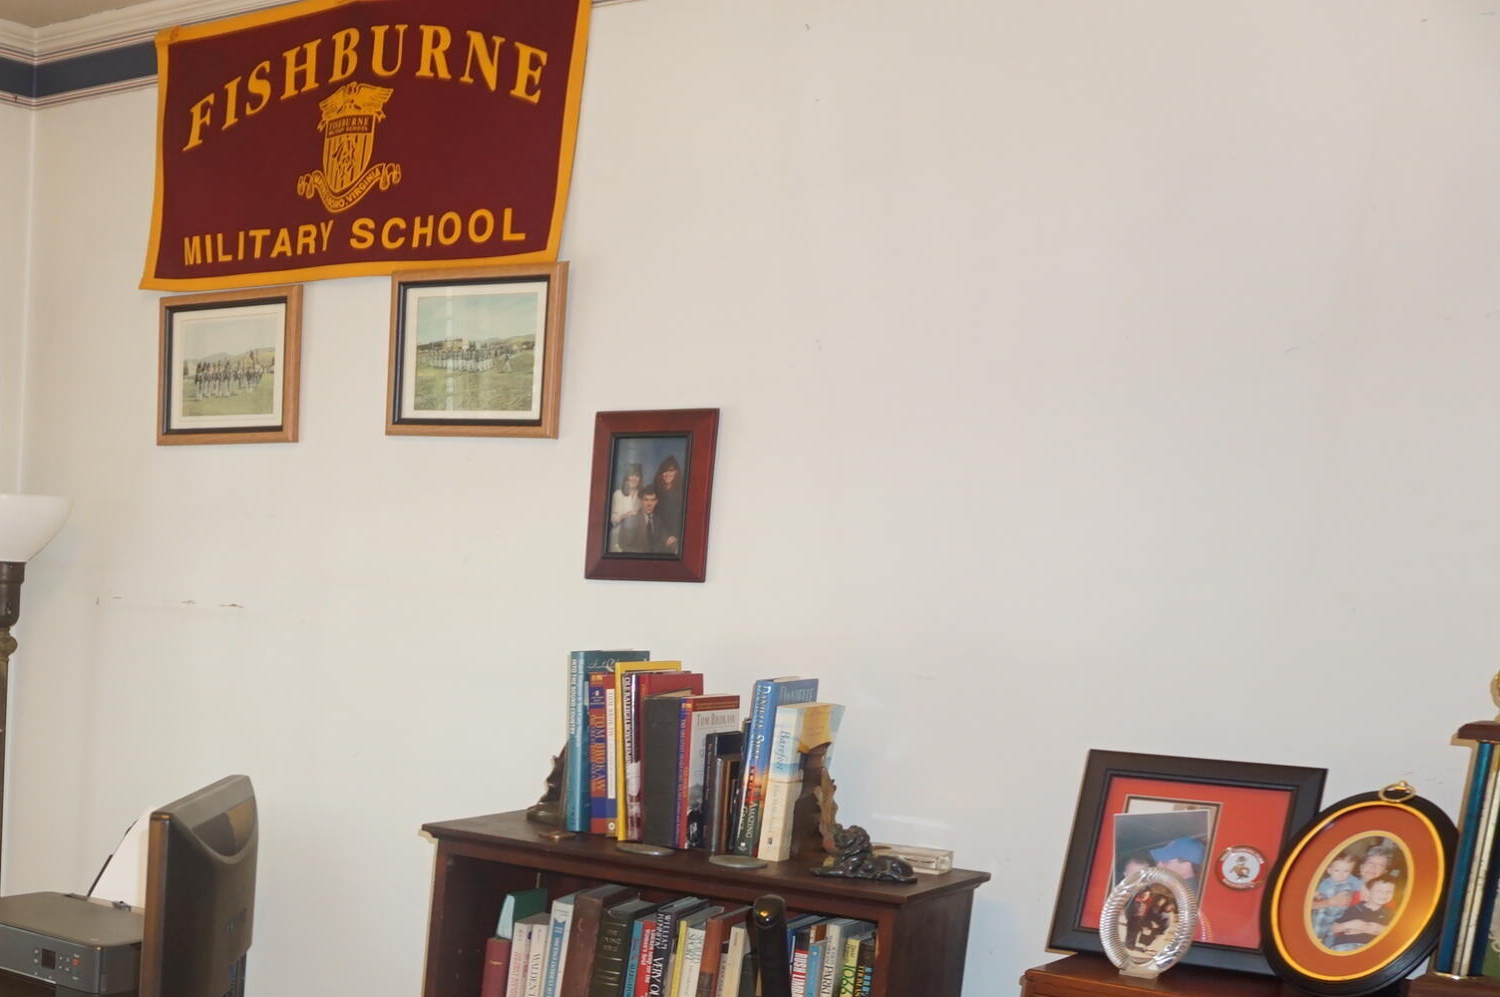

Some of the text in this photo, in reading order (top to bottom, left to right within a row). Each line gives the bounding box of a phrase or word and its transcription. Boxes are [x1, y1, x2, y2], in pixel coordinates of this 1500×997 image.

[182, 24, 549, 152] FISHBURNE
[183, 207, 526, 266] MILITARY SCHOOL
[595, 714, 606, 792] TOM BROKAW
[776, 730, 790, 770] Barefoot
[745, 802, 758, 839] AMAZING
[660, 914, 671, 950] WILLIAM
[528, 953, 540, 991] WALDEN
[651, 957, 664, 983] VERY
[792, 952, 808, 973] RUSH
[840, 965, 856, 995] 1066
[854, 965, 865, 995] THOMAS
